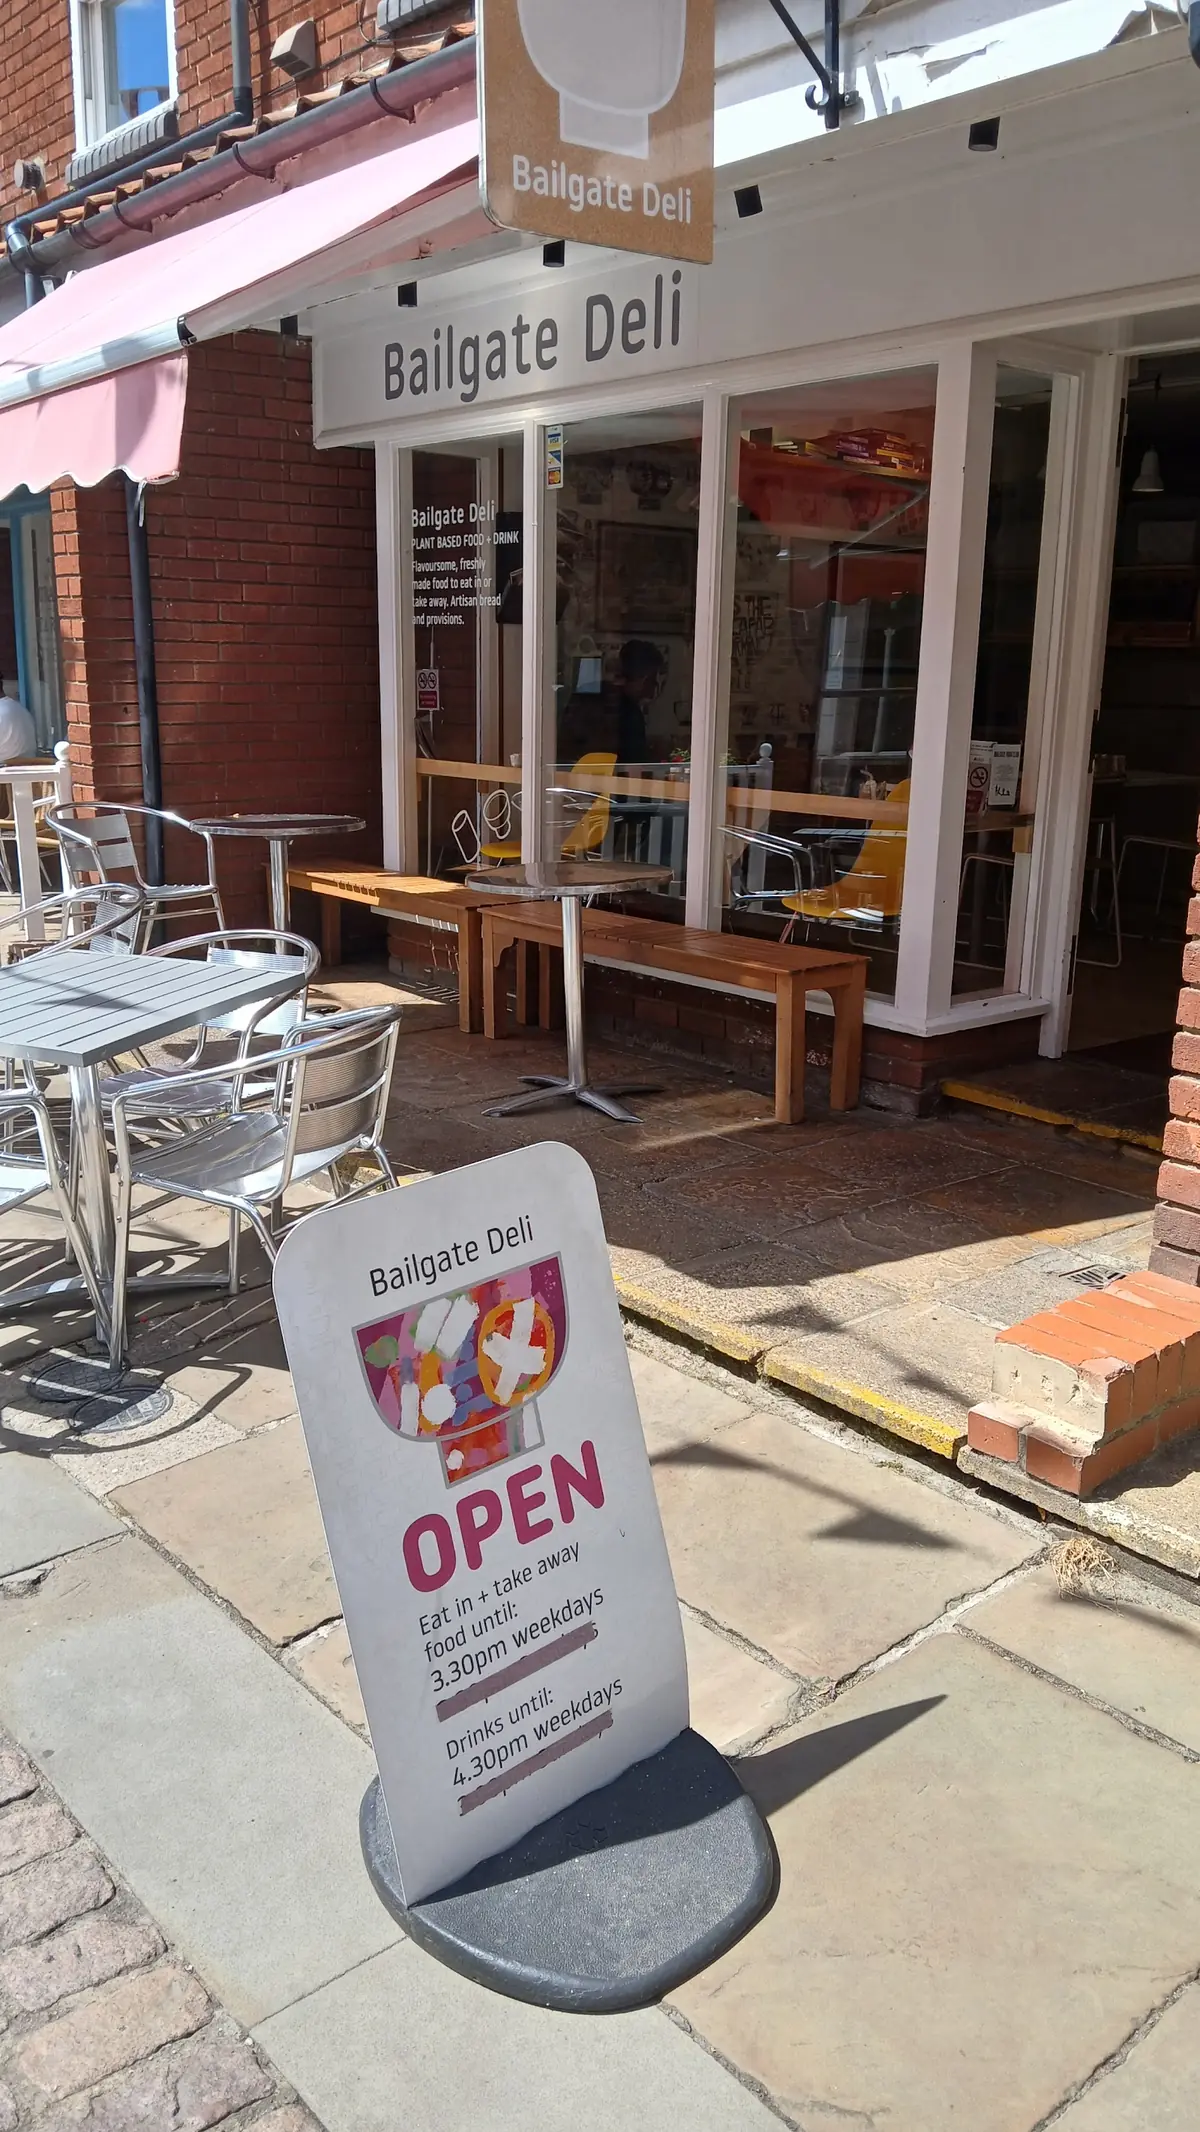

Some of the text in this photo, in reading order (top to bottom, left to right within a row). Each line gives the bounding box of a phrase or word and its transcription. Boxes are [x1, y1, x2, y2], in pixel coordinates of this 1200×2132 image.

[512, 154, 692, 224] Bailgate Deli
[384, 269, 682, 403] Bailgate Deli
[411, 500, 495, 531] Bailgate Deli
[411, 537, 435, 550] PLANT
[437, 535, 462, 549] BASED
[463, 533, 484, 547] FOOD
[493, 530, 520, 545] DRINK
[411, 556, 487, 573] Flavoursome, freshly
[412, 575, 492, 590] made food to eat in or
[412, 593, 502, 610] take away. Artisan bread
[412, 612, 465, 627] and provisions.
[369, 1214, 534, 1297] Bailgate Deli
[402, 1440, 605, 1593] OPEN
[419, 1541, 581, 1636] Eat in + take away
[424, 1601, 519, 1663] food until:
[430, 1639, 508, 1692] 3.30pm
[511, 1587, 604, 1649] weekdays
[446, 1688, 555, 1760] Drinks until:
[452, 1733, 528, 1786] 4.30pm
[533, 1678, 623, 1741] weekdays
